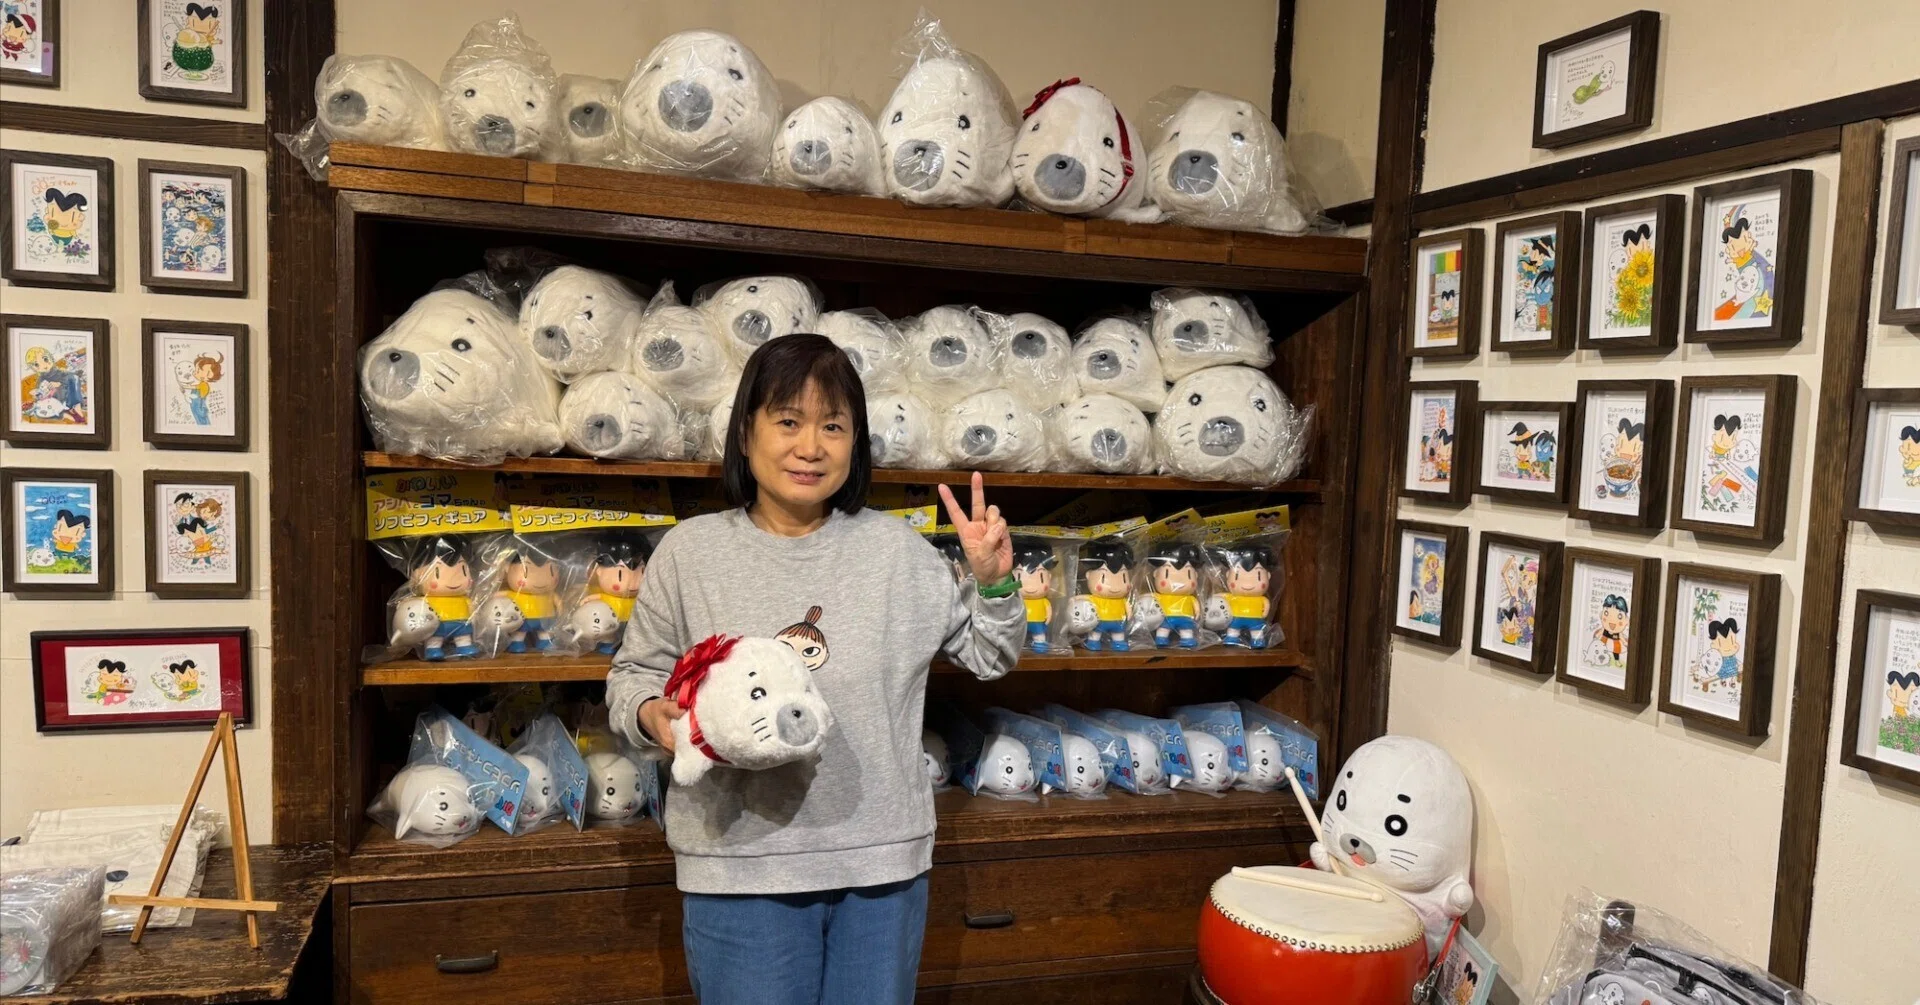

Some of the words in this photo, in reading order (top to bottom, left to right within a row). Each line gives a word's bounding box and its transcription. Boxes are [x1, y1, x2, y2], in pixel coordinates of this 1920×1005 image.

[374, 510, 487, 531] ソフビフィギュア
[519, 510, 630, 527] ソフビフィギュア
